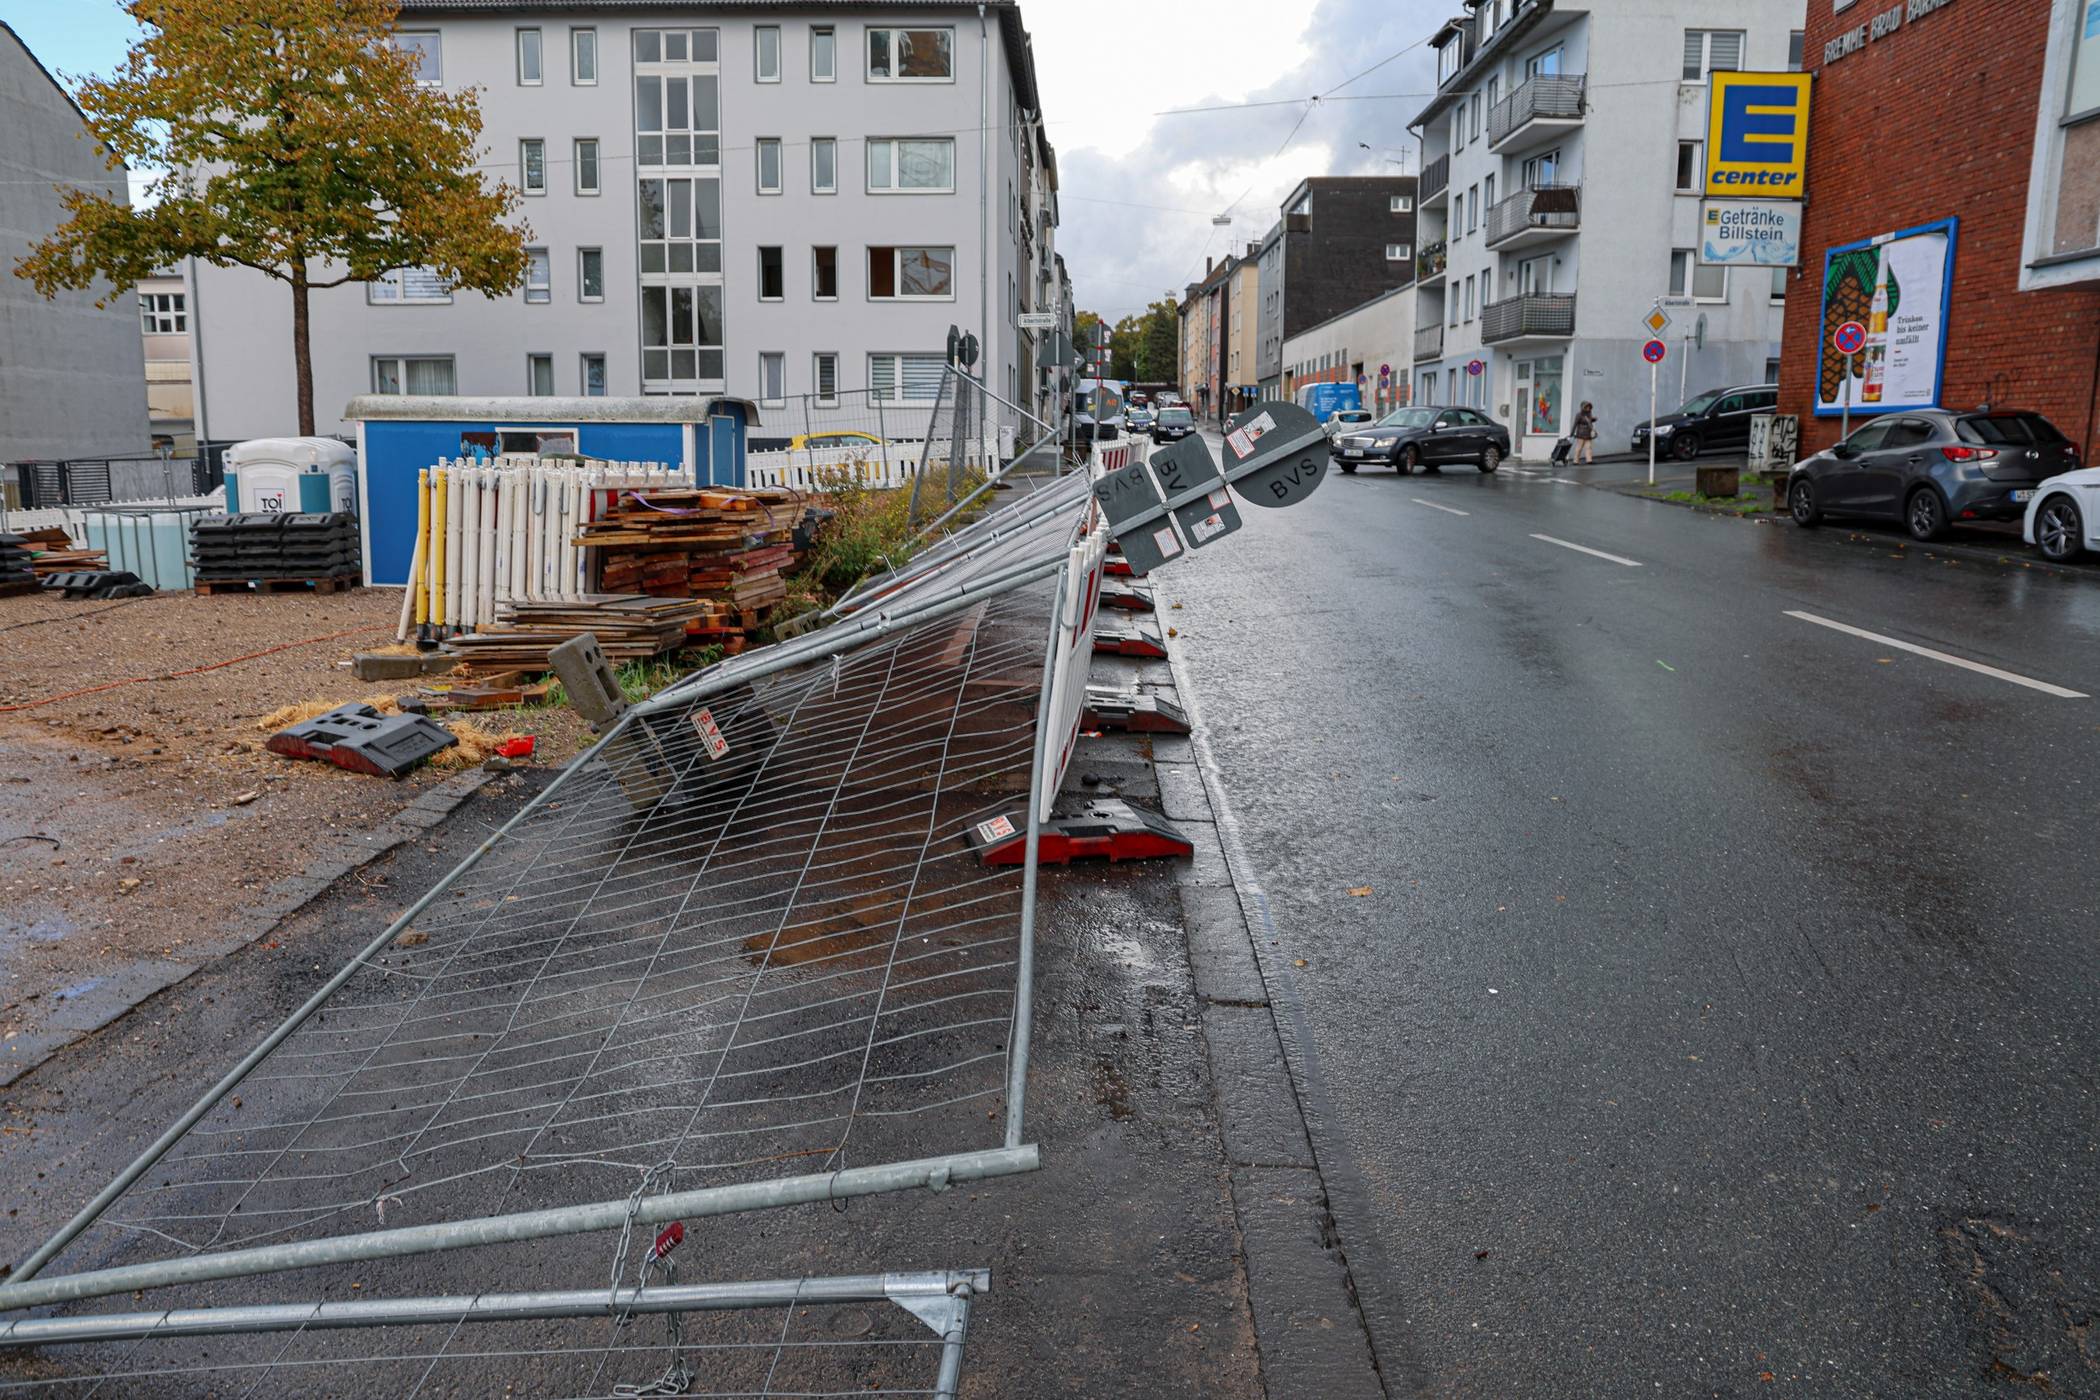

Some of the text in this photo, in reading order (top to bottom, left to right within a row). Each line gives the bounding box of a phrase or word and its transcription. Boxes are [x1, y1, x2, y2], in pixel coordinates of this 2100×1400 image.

[1720, 85, 1798, 163] E
[1712, 170, 1797, 185] center
[1721, 206, 1784, 225] Getränke
[1720, 226, 1783, 240] Billstein
[1908, 324, 1930, 333] keiner
[1097, 467, 1145, 502] BVS
[1270, 459, 1317, 499] BVS
[700, 712, 726, 752] BVS
